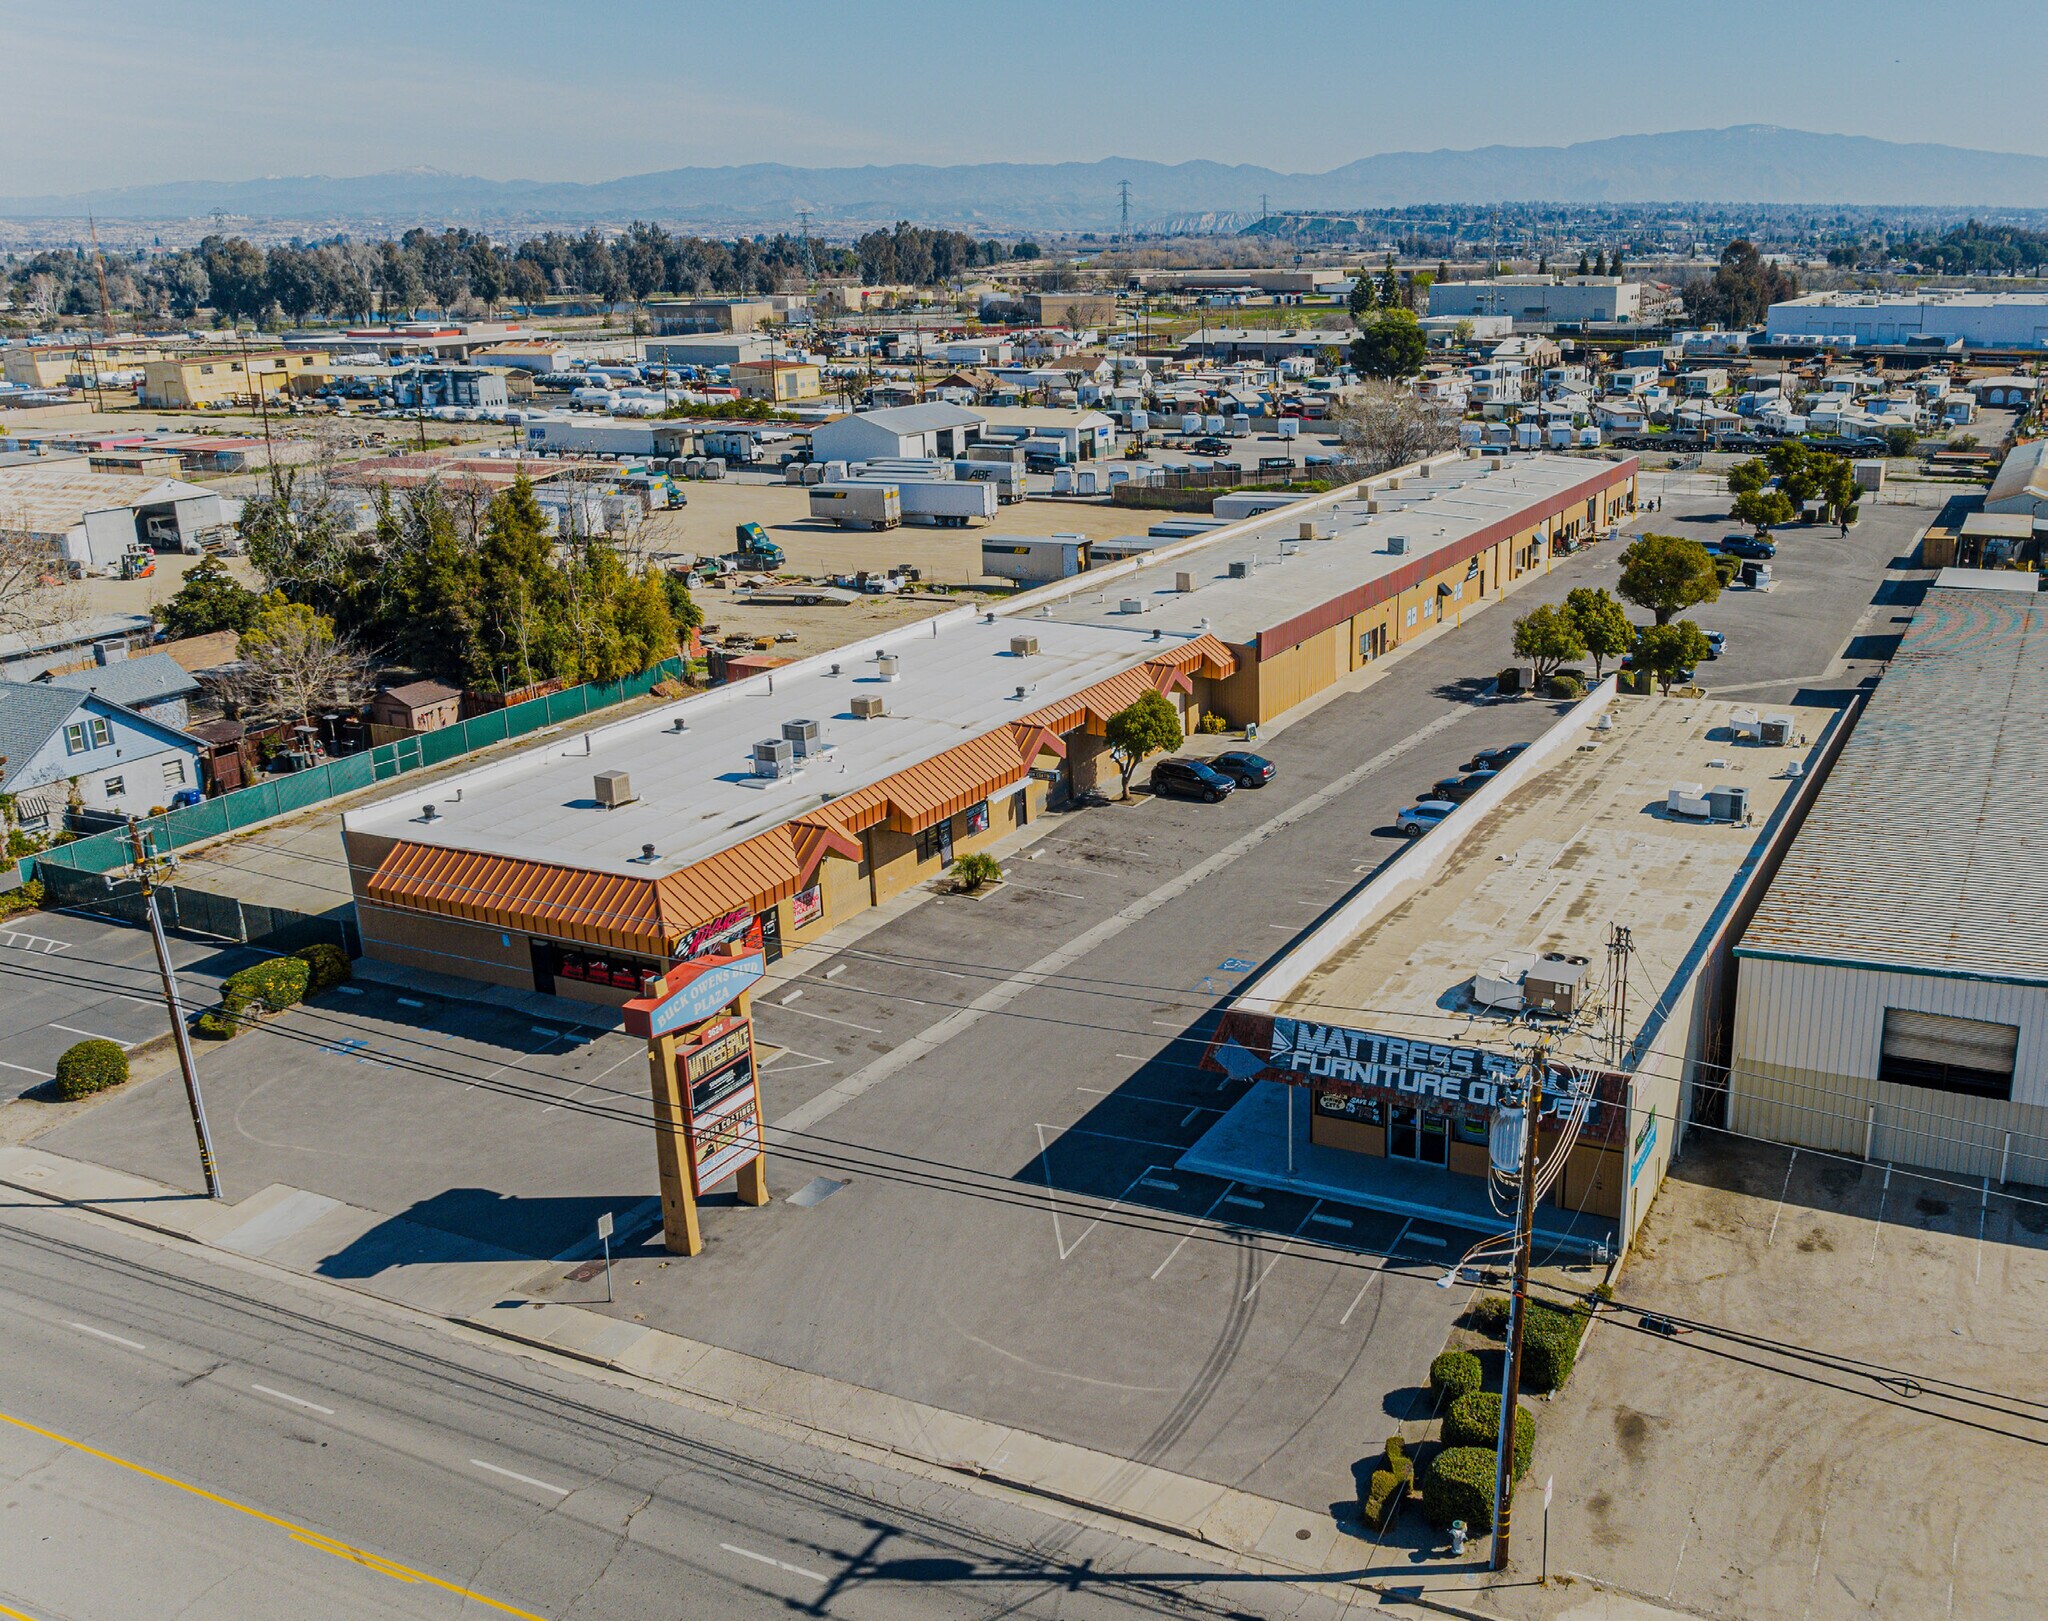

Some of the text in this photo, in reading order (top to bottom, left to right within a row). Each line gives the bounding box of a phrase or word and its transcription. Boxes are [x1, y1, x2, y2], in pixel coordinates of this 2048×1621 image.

[968, 469, 993, 480] ABF
[657, 993, 690, 1028] BUCK
[690, 969, 730, 1000] OWENS
[731, 961, 759, 979] BLVD
[693, 986, 730, 1016] PLAZA
[1296, 1022, 1475, 1078] MATTRESS
[1290, 1049, 1598, 1123] FURNITURE OET
[721, 1101, 756, 1129] COATINGS
[1350, 1097, 1378, 1108] SAVE UP
